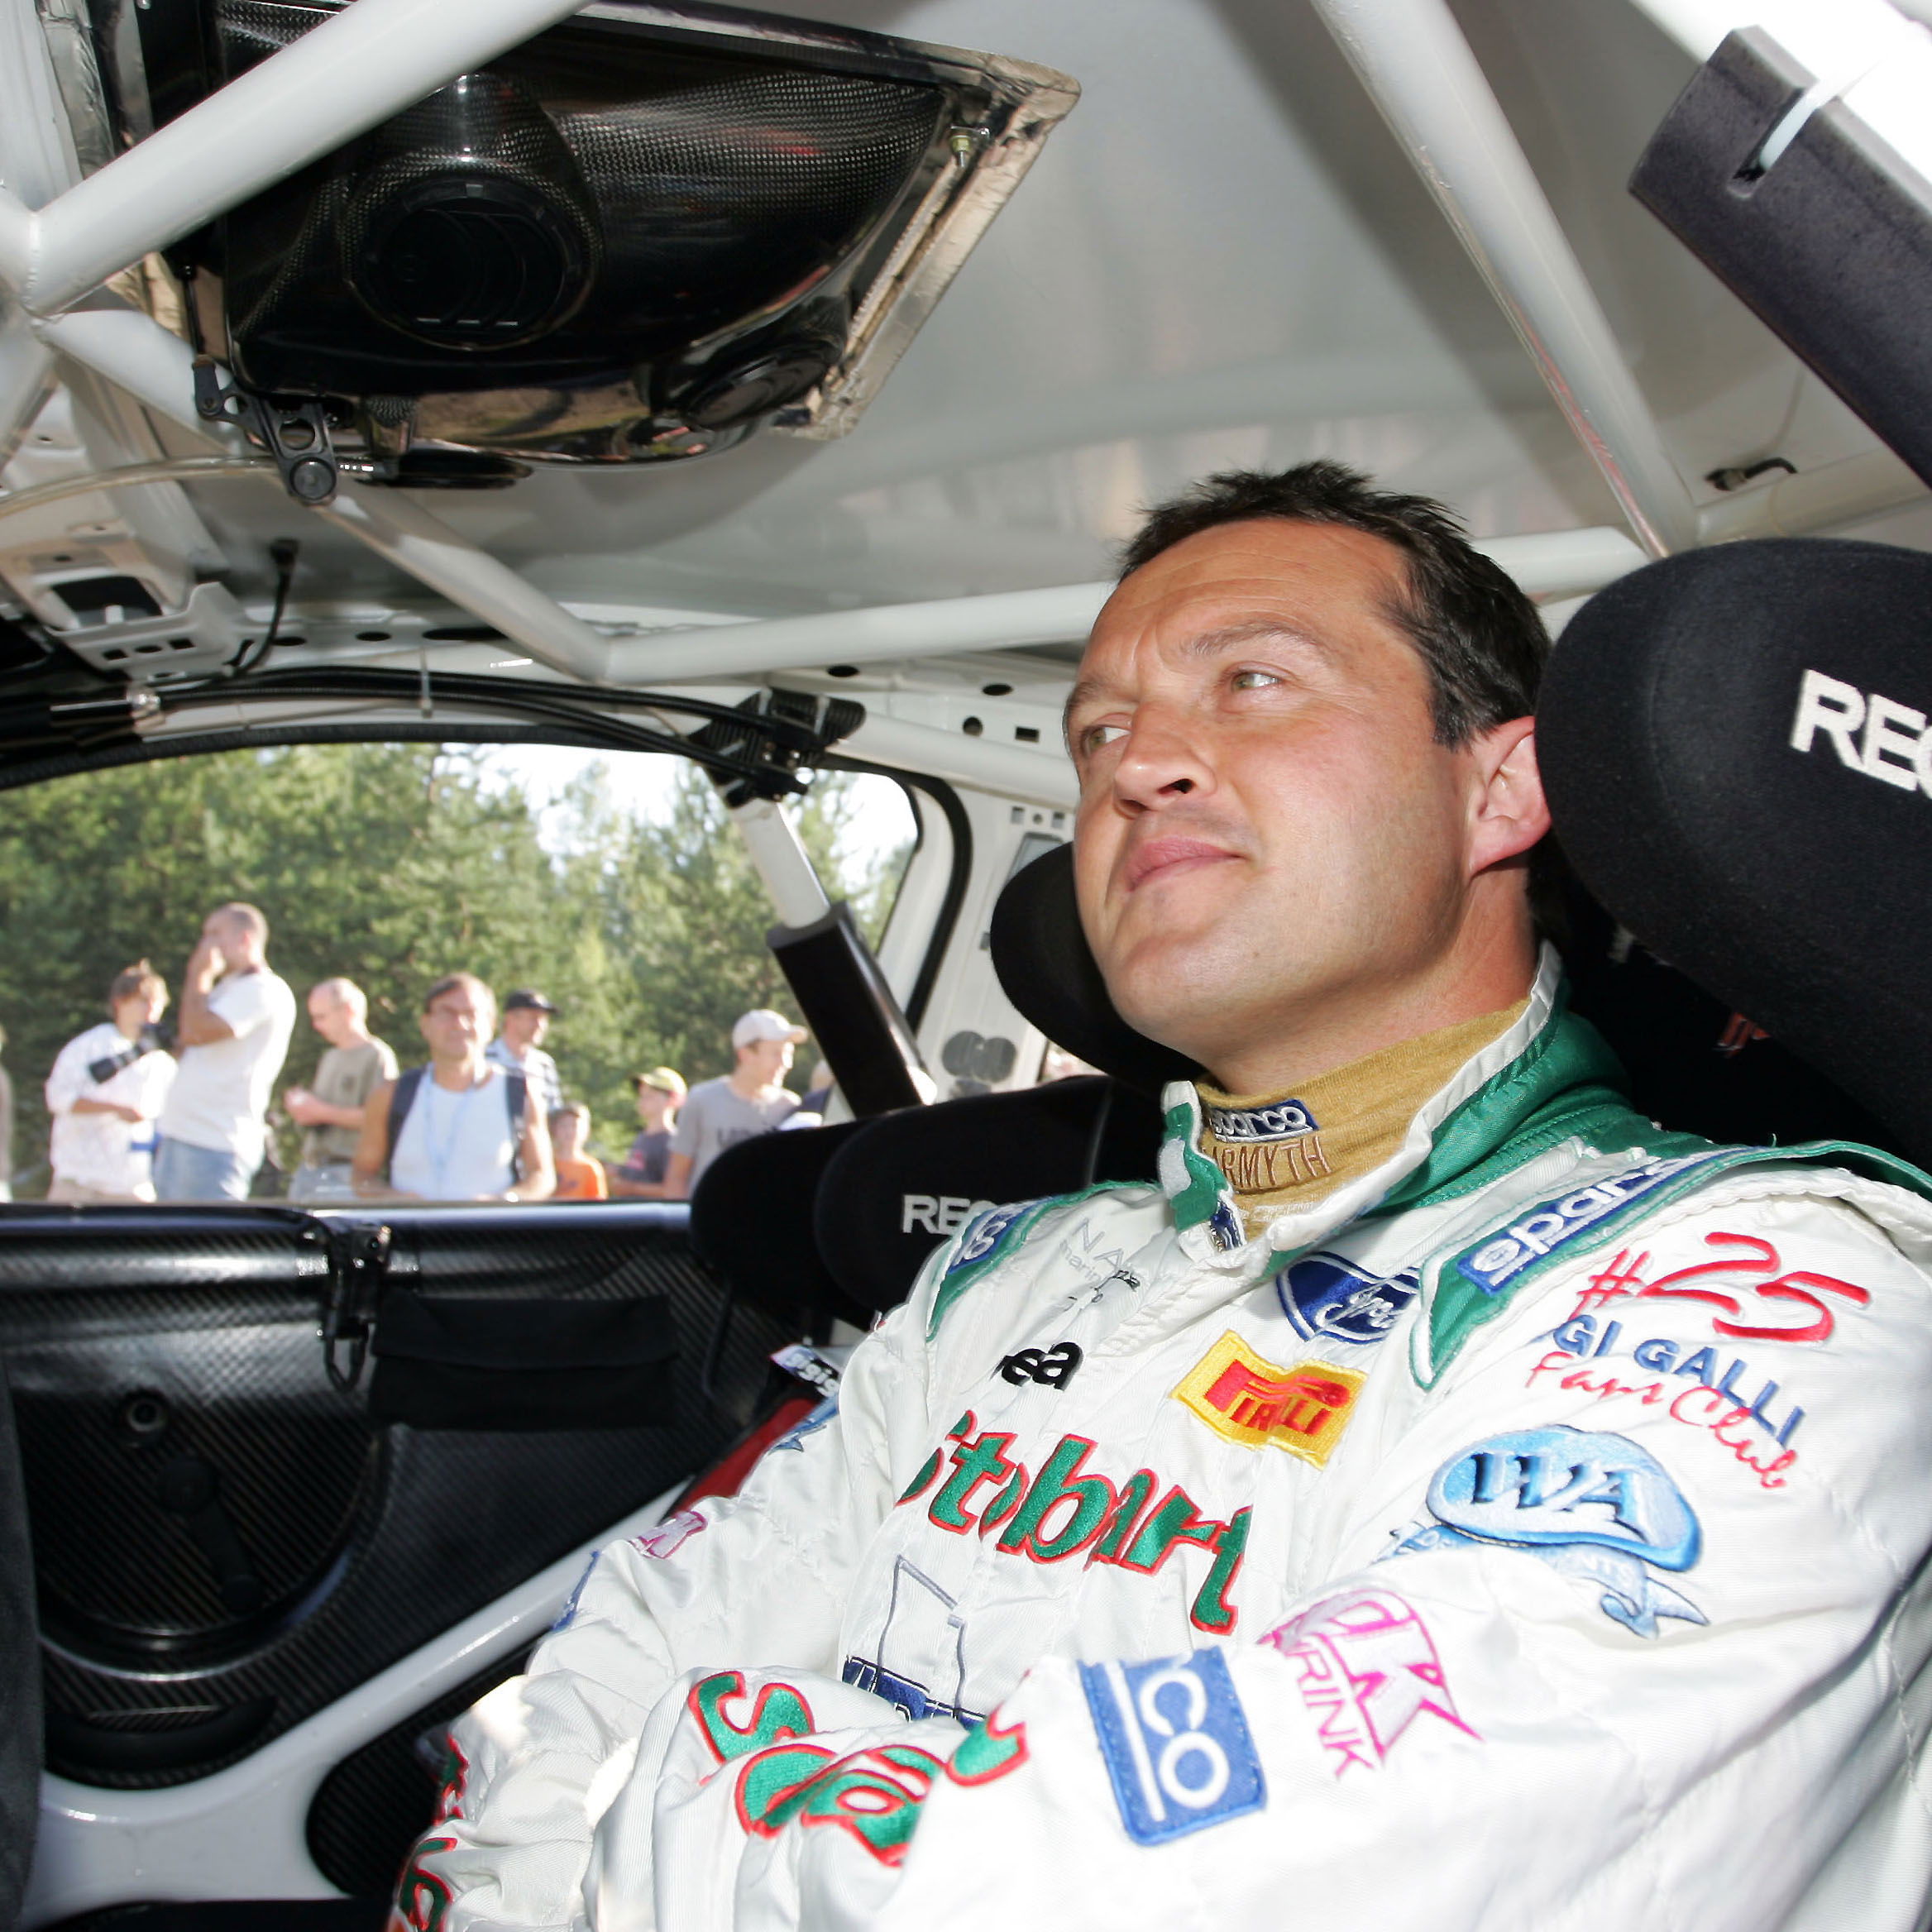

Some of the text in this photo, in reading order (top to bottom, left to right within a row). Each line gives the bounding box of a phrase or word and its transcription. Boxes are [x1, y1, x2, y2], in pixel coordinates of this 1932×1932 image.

[1572, 1231, 1871, 1342] #25
[1633, 1338, 1806, 1450] GALLI
[1669, 1385, 1799, 1489] Club
